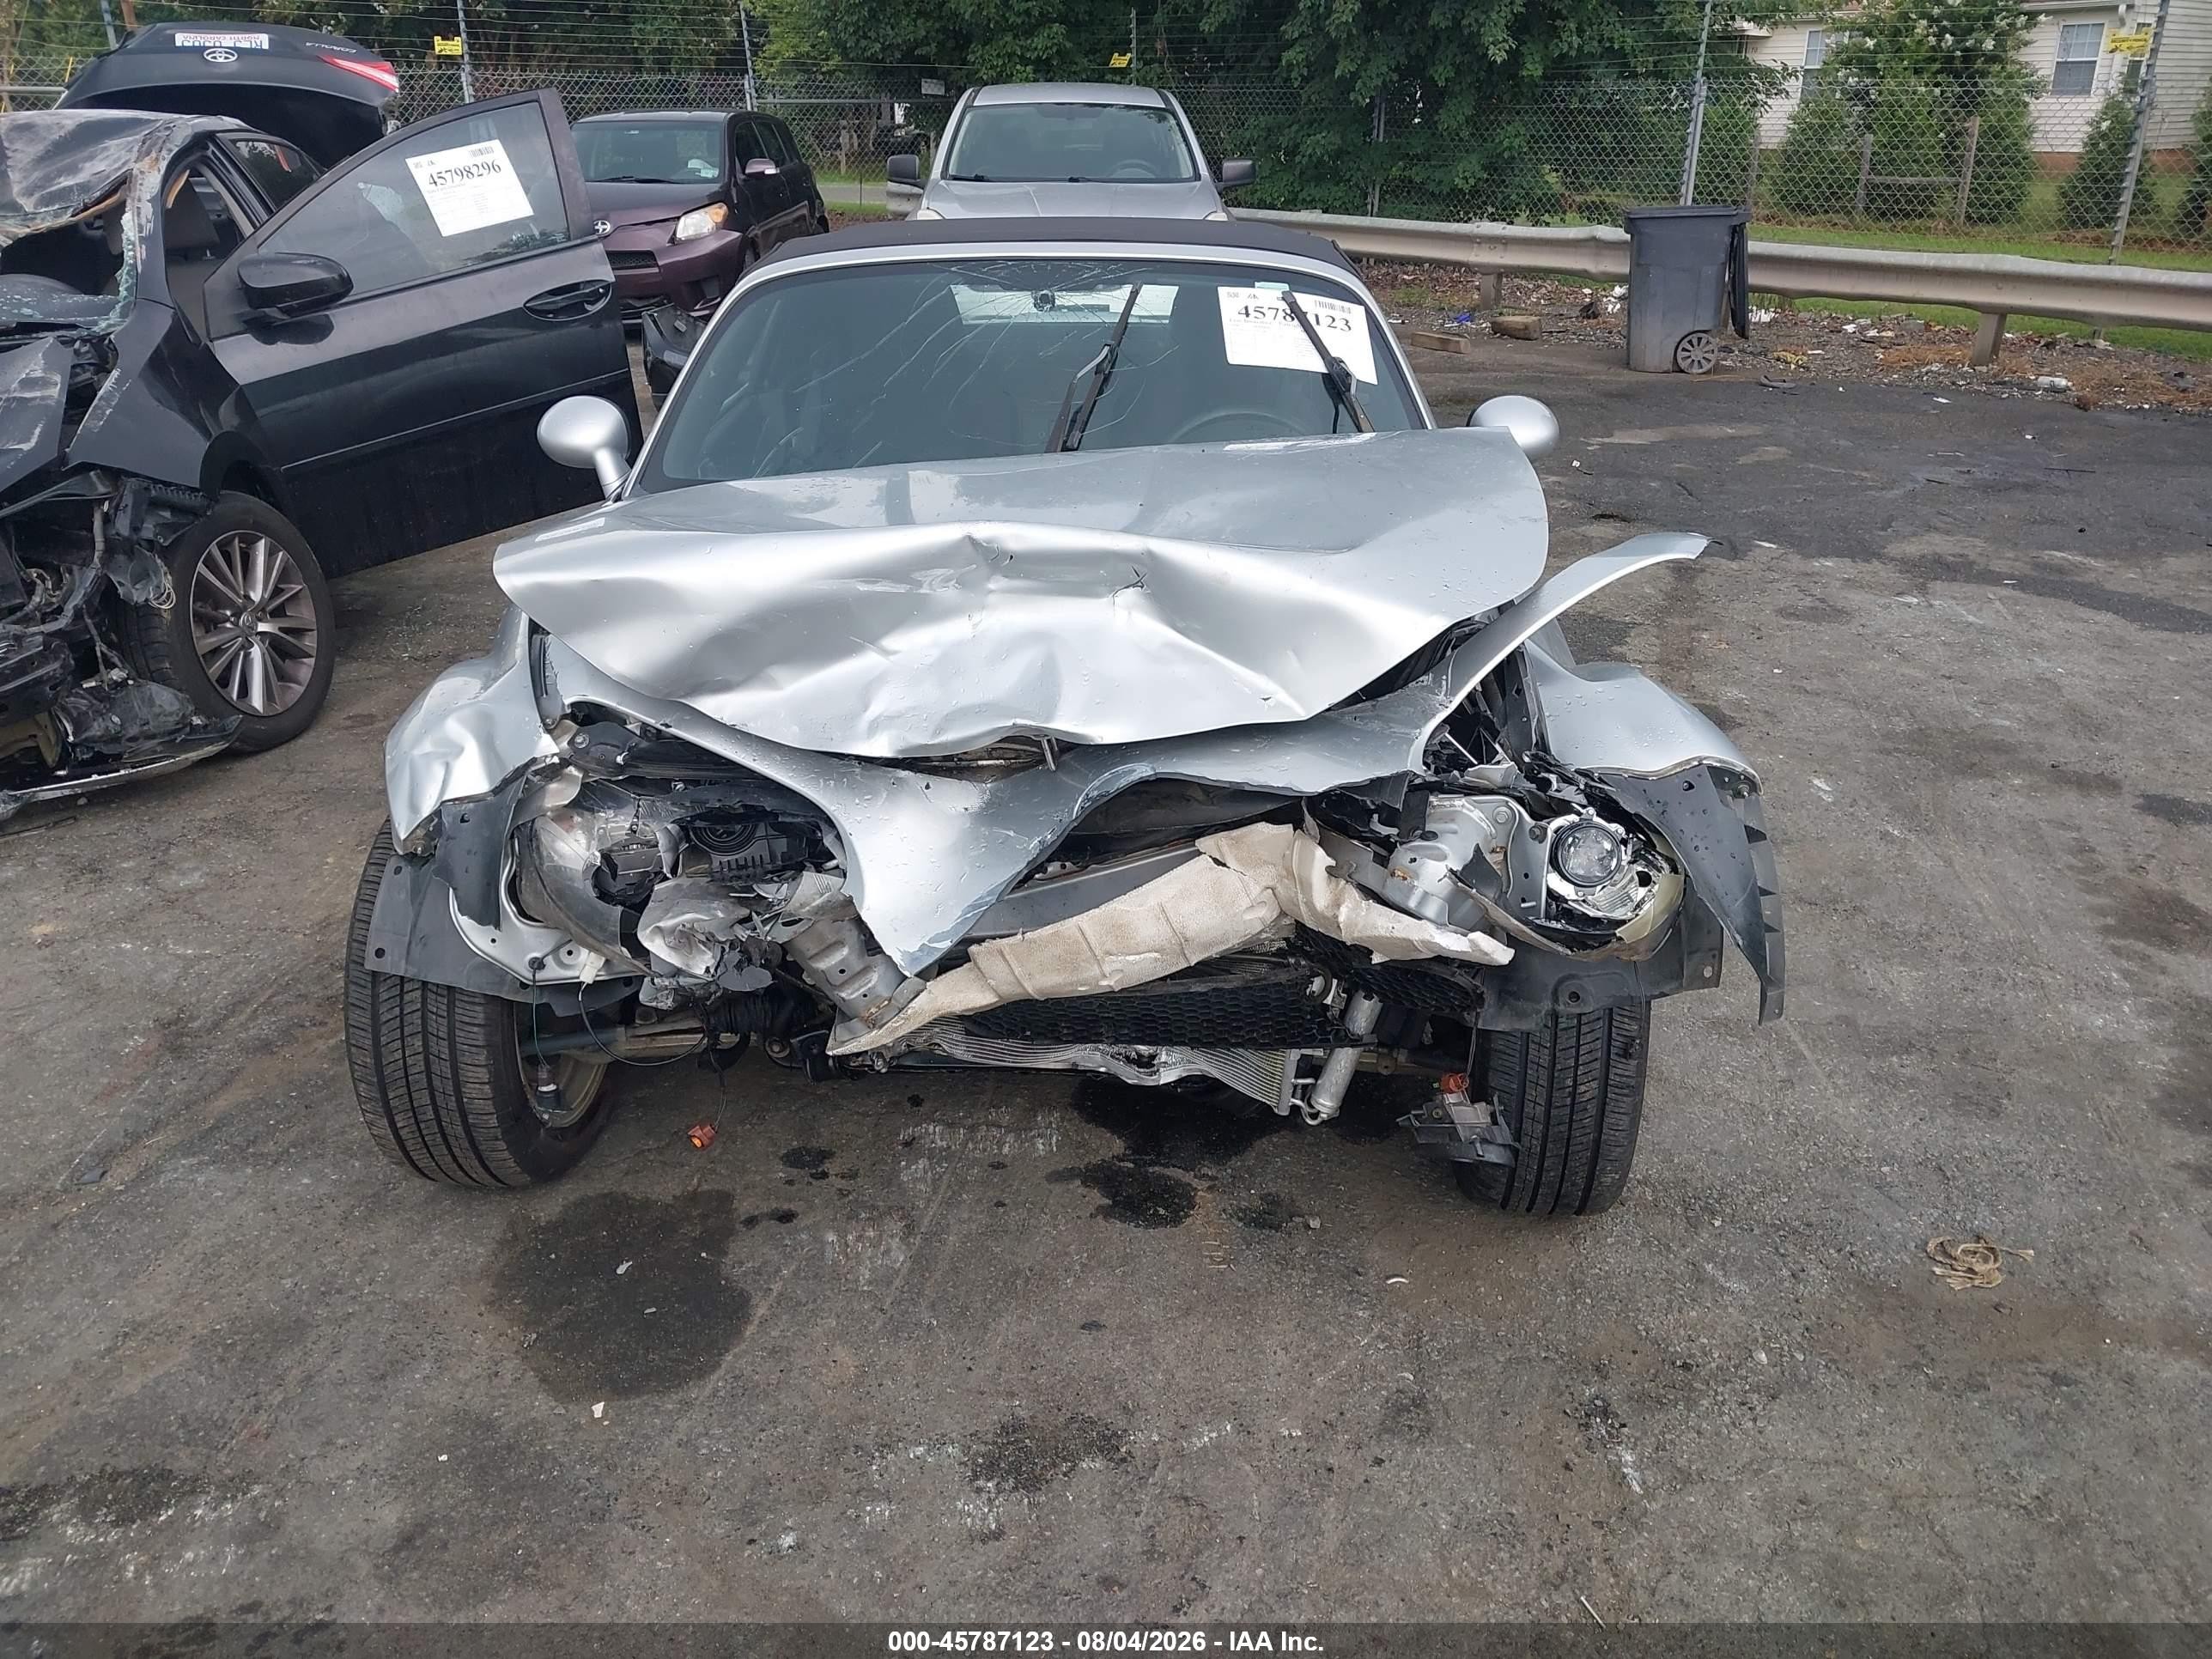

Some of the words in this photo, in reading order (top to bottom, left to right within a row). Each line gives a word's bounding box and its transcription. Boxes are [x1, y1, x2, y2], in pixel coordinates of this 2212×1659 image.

[305, 41, 357, 53] COROLLA
[428, 159, 501, 187] 45798296
[1237, 304, 1352, 332] 4578123
